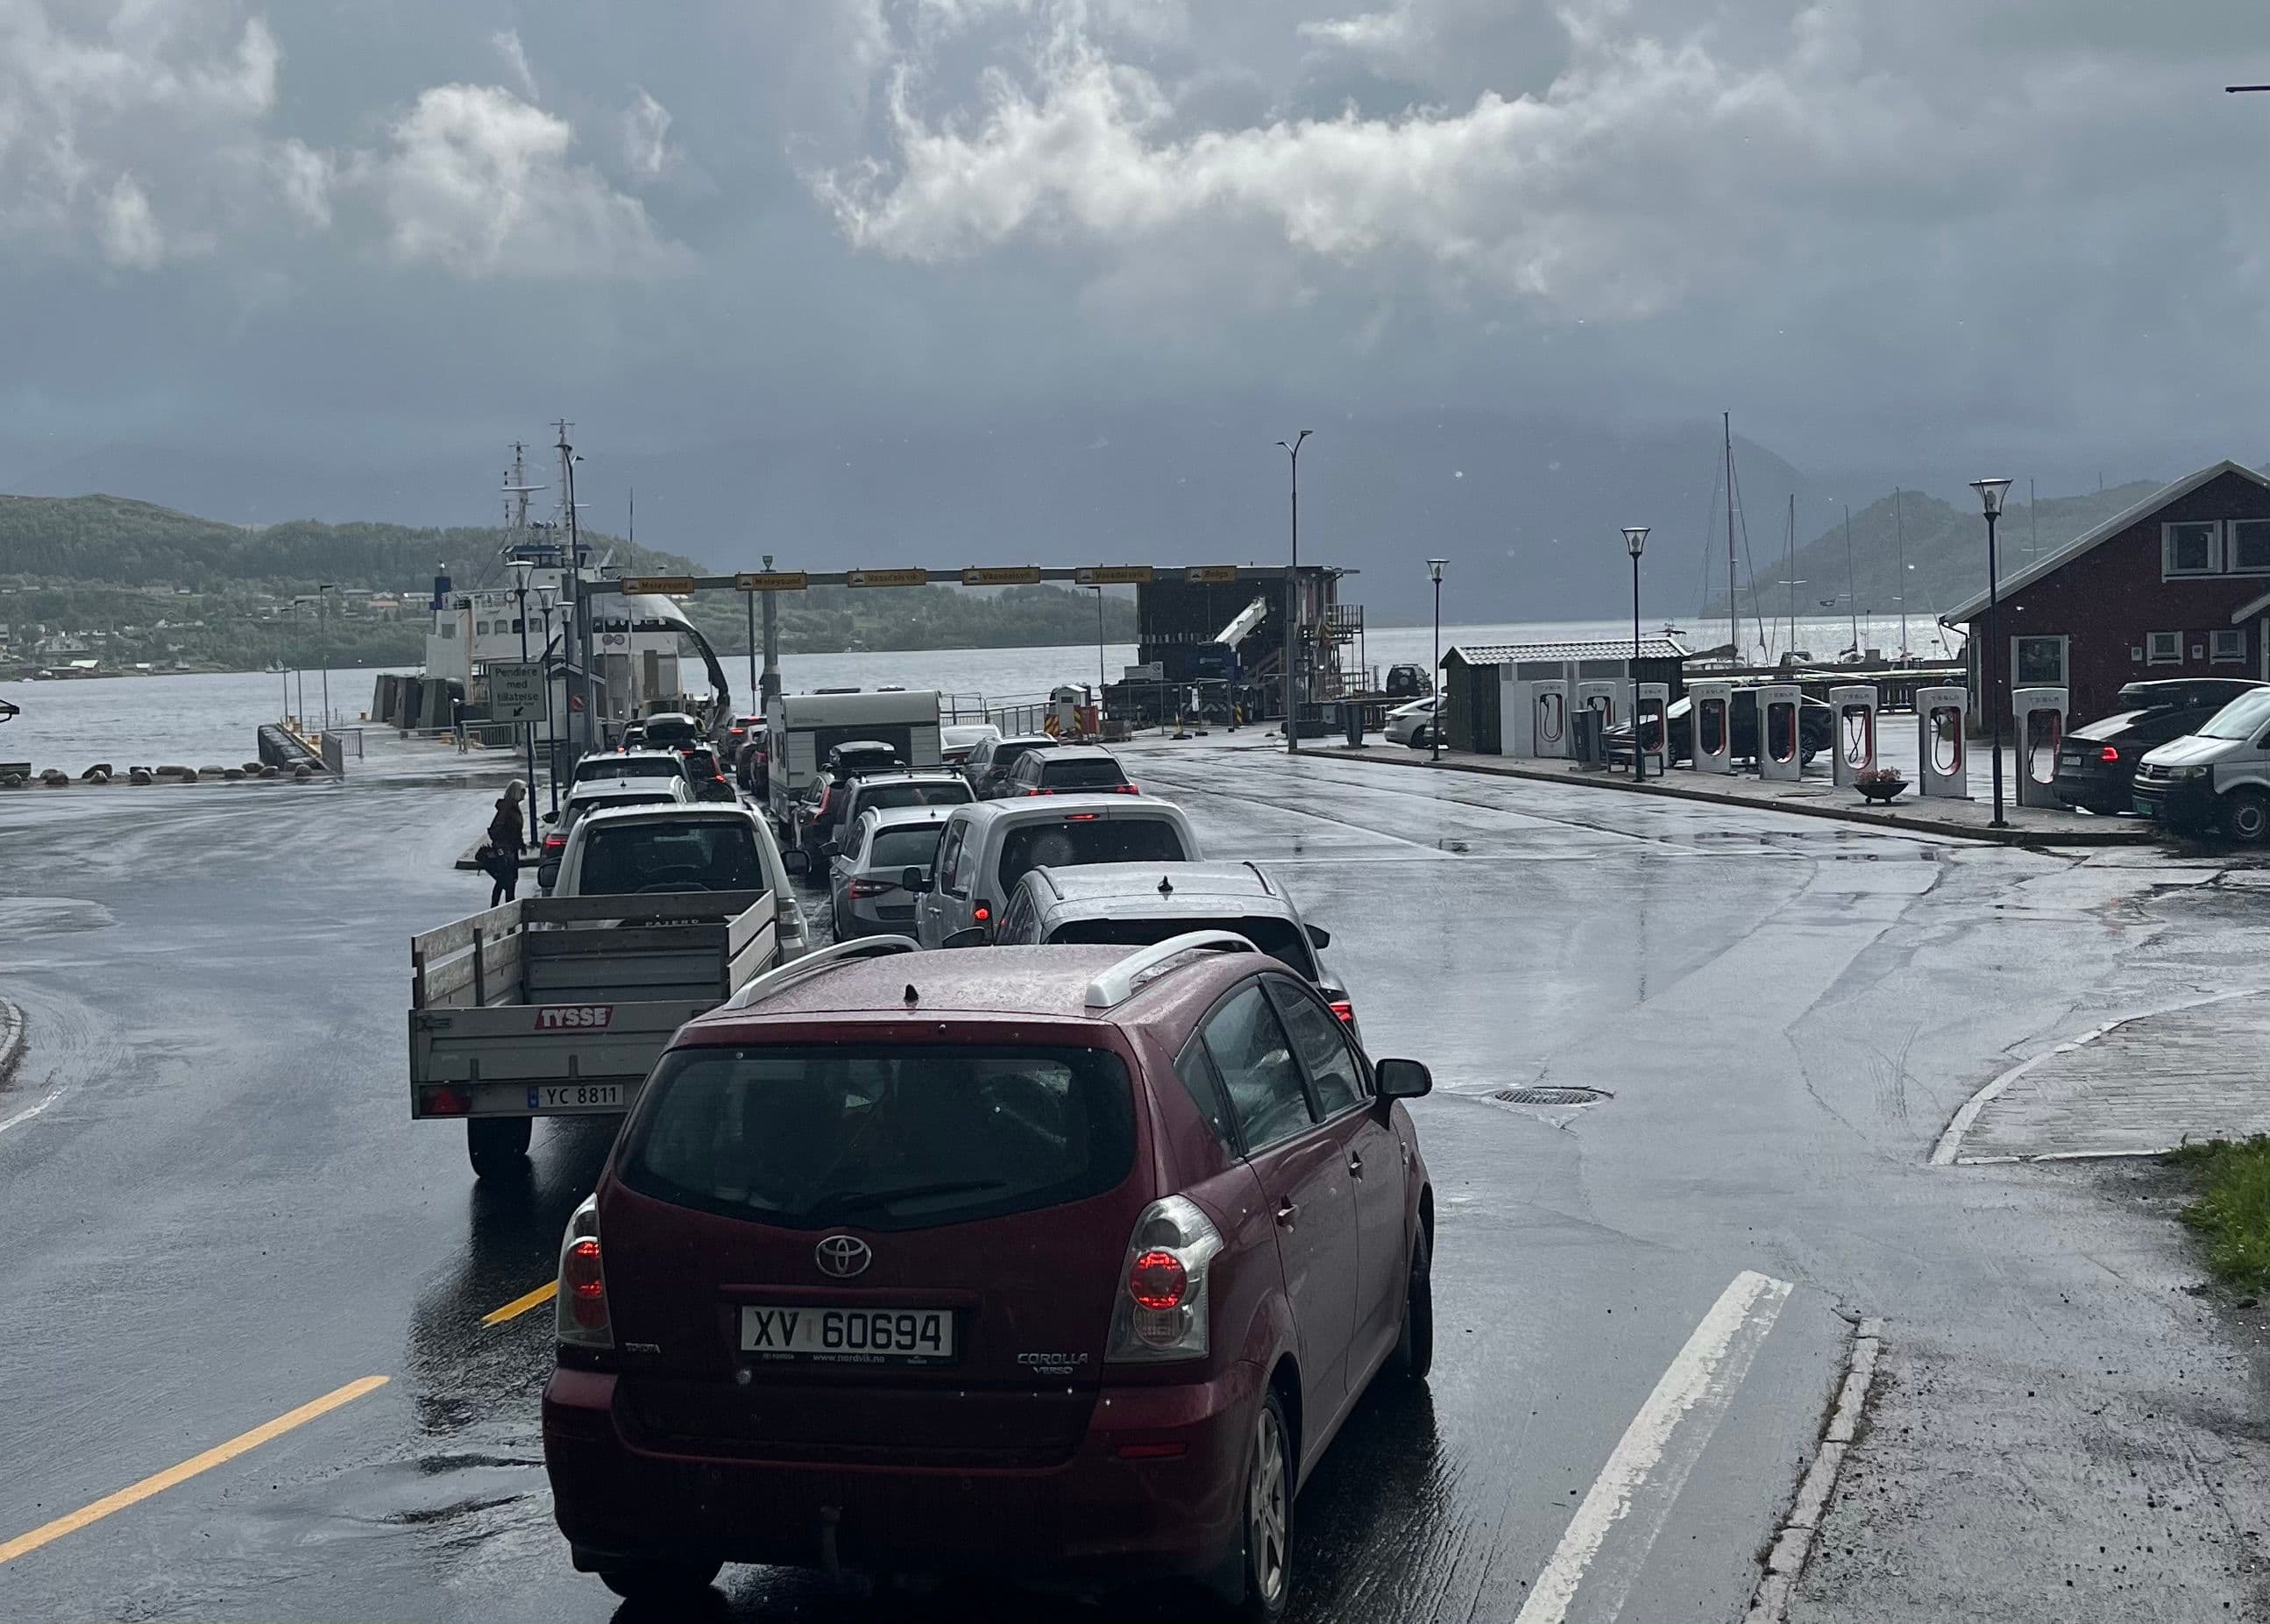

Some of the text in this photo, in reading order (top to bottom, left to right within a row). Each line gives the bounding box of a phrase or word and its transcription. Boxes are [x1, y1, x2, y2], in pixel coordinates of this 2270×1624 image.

[495, 667, 537, 677] Pendlere
[507, 679, 528, 689] med
[497, 692, 539, 701] tillatelse
[542, 1007, 607, 1027] TYSSE
[547, 1087, 616, 1104] YC 8811
[754, 1310, 941, 1351] XV 60694
[812, 1353, 885, 1364] www.nordvik.no
[1017, 1352, 1089, 1365] COROLLA
